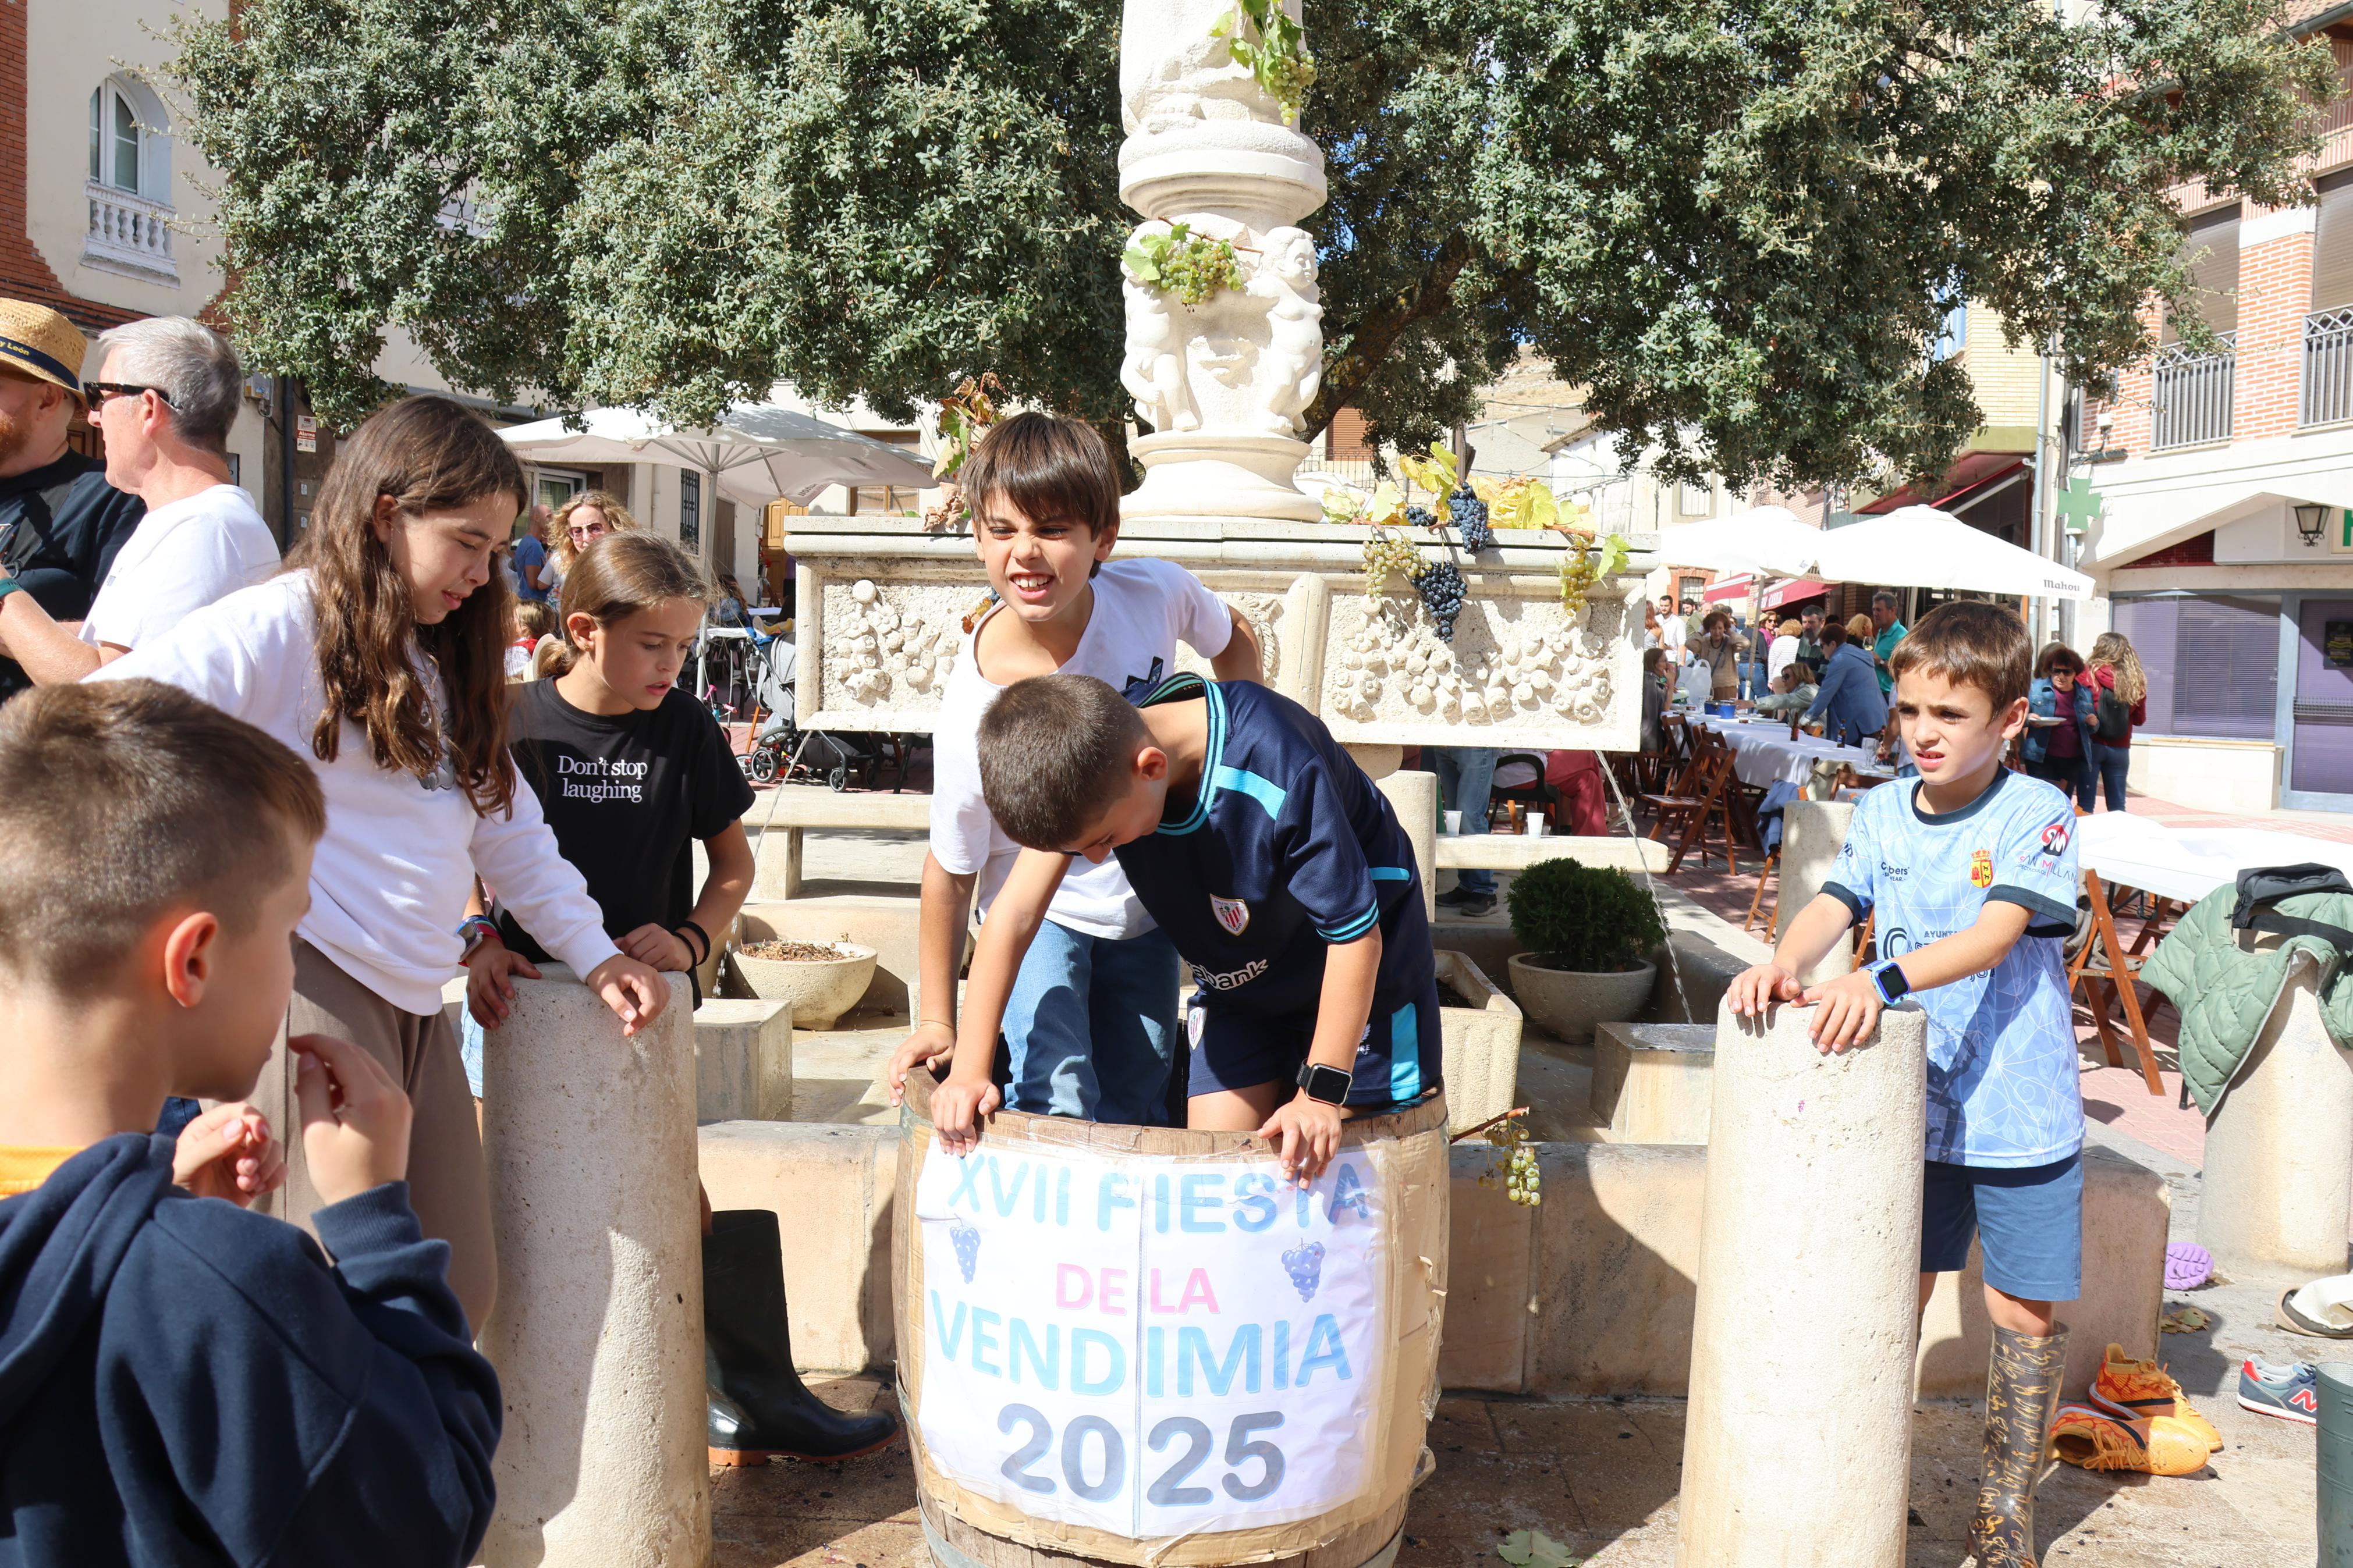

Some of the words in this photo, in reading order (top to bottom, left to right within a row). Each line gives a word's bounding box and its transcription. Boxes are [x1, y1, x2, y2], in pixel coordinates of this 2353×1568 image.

[7, 342, 30, 355] León
[2043, 579, 2081, 592] Mahou
[556, 755, 609, 776] Don't
[611, 759, 648, 780] stop
[562, 778, 643, 803] laughing
[1187, 959, 1269, 991] abank
[947, 1154, 1071, 1226] XVII
[1097, 1163, 1370, 1234] FIESTA
[1055, 1263, 1128, 1316] DE
[1149, 1267, 1220, 1315] LA
[930, 1288, 1353, 1398] VENDIMIA
[996, 1403, 1286, 1507] 2025
